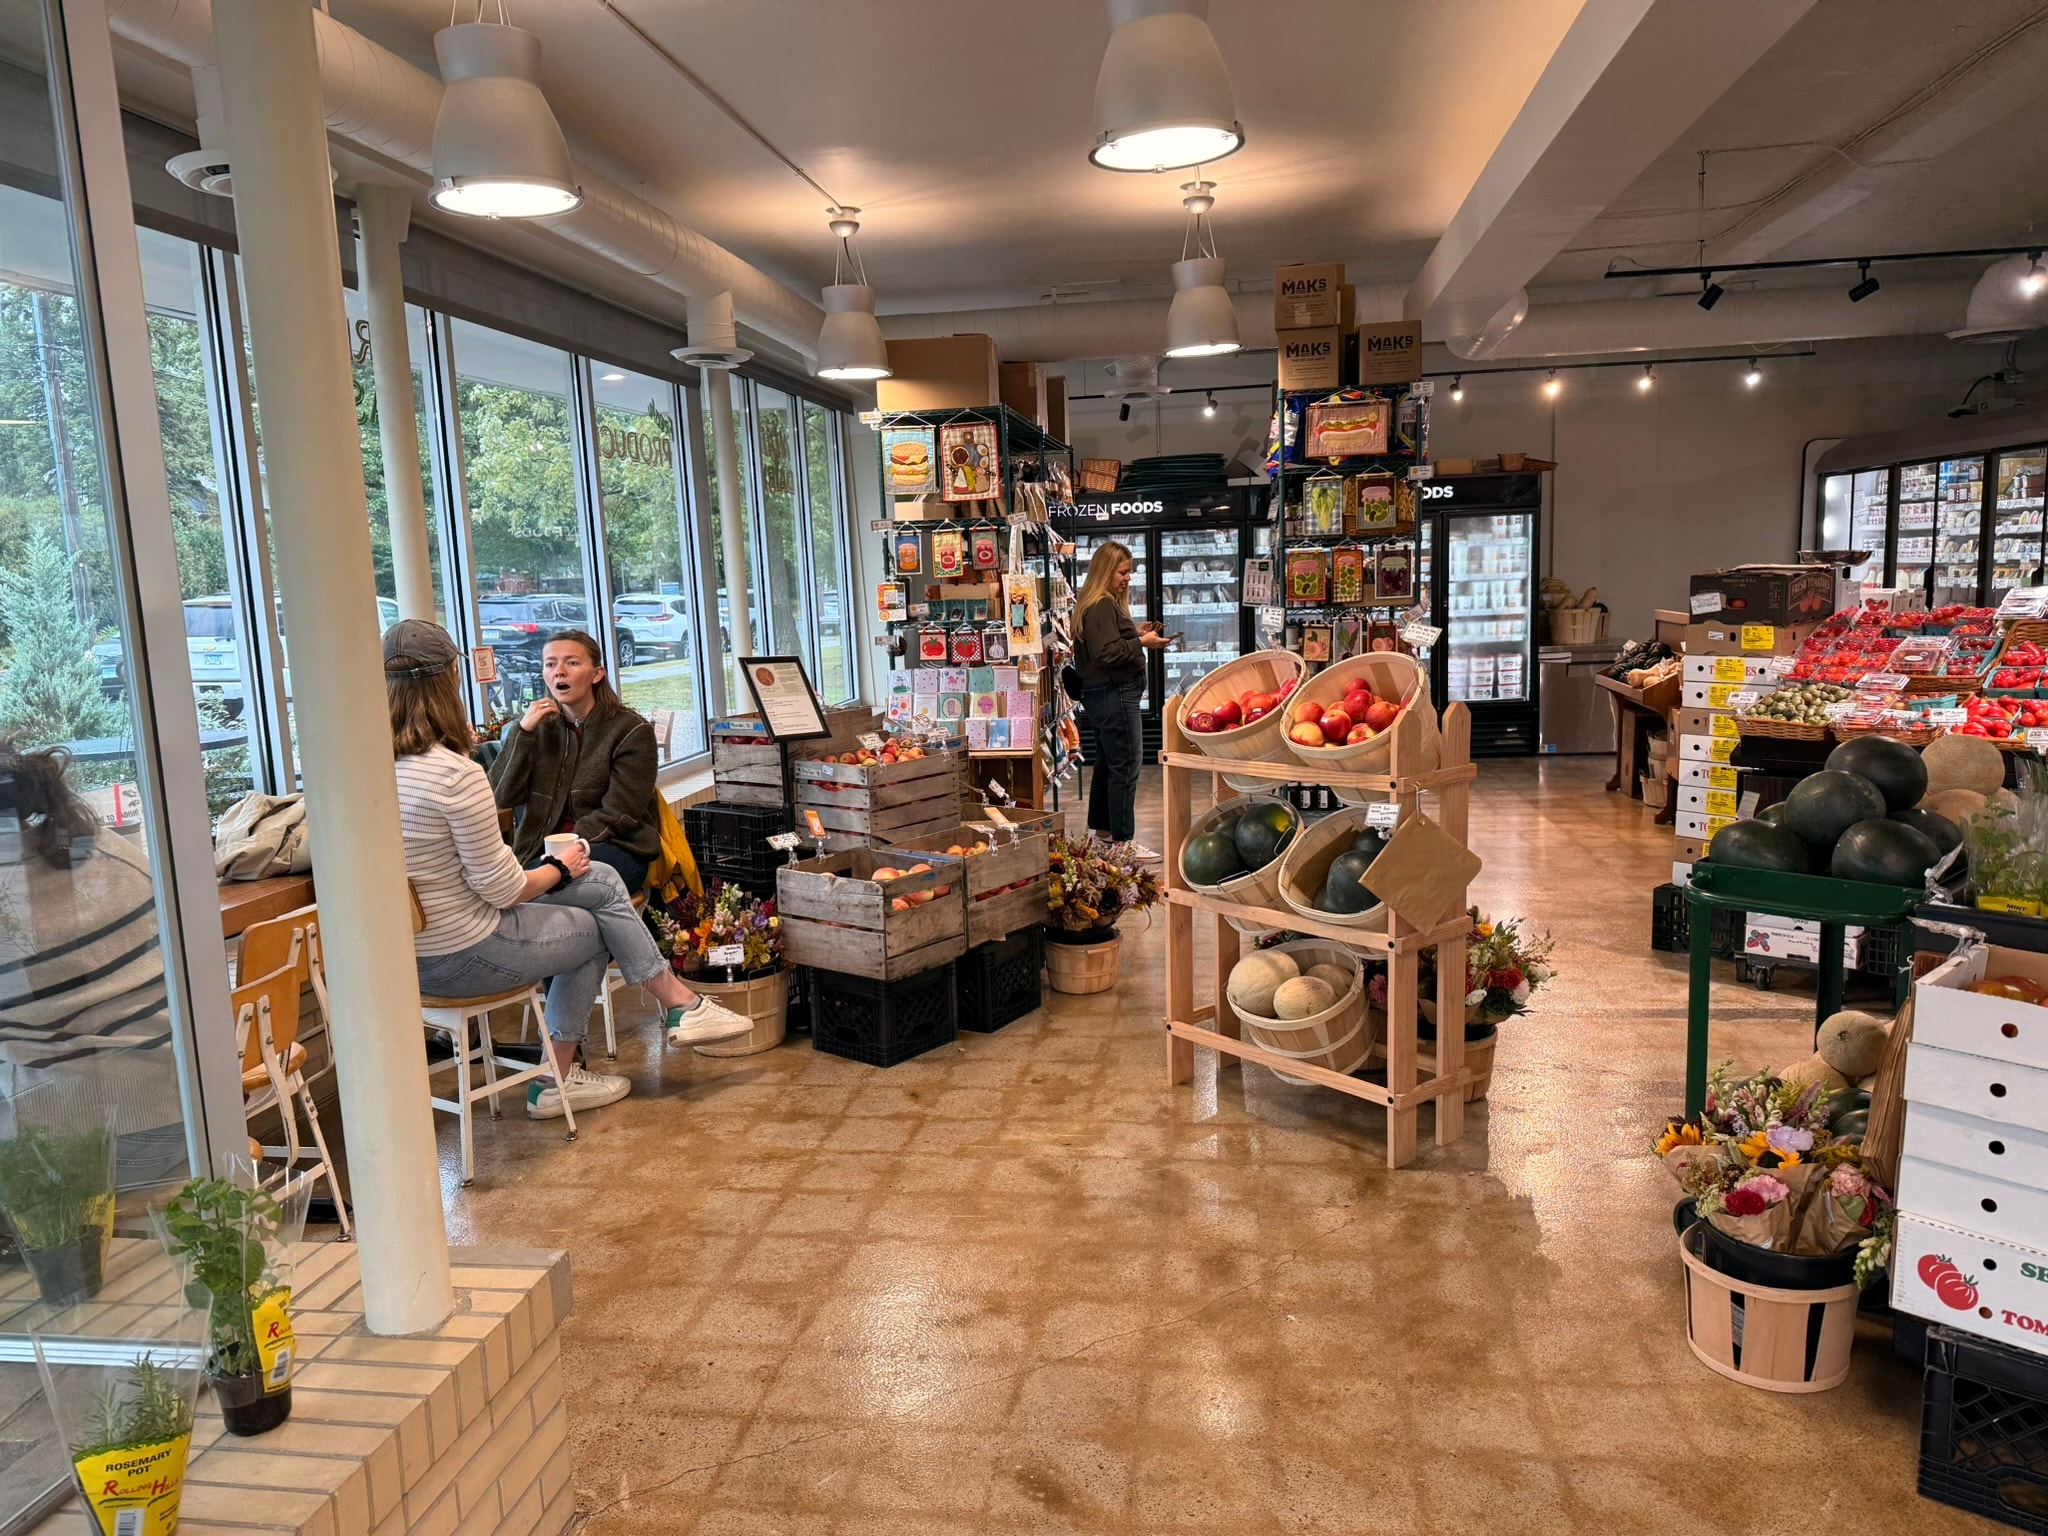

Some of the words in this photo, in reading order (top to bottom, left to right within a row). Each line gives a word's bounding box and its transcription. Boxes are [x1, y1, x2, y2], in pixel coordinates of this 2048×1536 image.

[1282, 278, 1327, 295] MAKS
[1286, 342, 1331, 358] MAKS
[1368, 335, 1413, 352] MAKS
[1422, 485, 1454, 499] ODS
[1048, 503, 1107, 518] FROZEN
[1111, 501, 1163, 515] FOODS
[121, 809, 140, 819] ADISH!
[105, 1448, 173, 1472] ROSEMARY
[127, 1464, 152, 1477] POT
